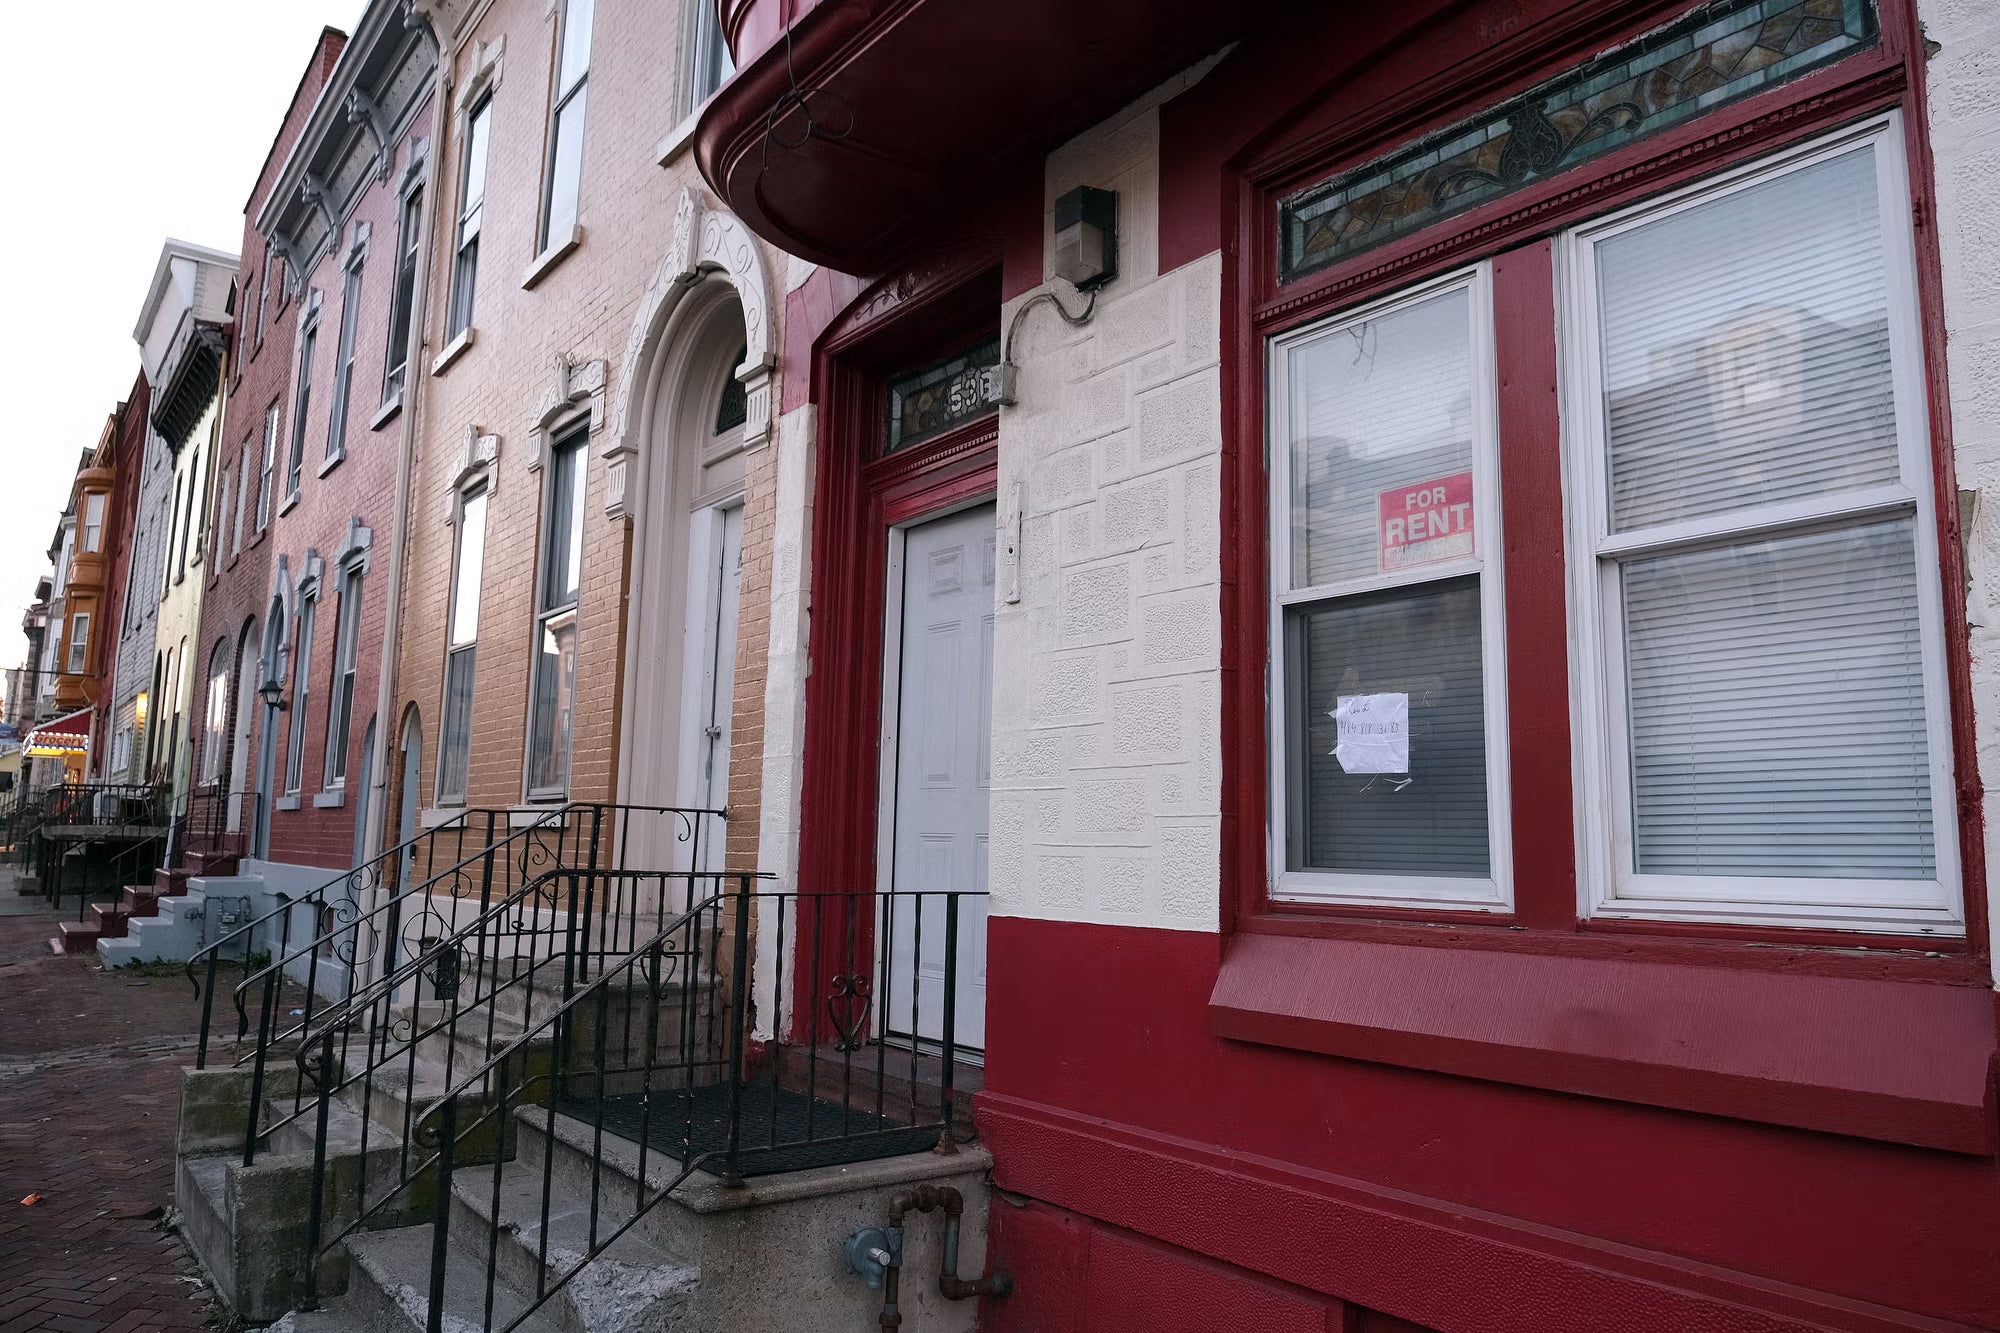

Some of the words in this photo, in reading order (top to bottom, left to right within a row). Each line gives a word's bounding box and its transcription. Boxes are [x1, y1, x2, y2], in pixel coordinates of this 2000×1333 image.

[1405, 486, 1446, 511] FOR
[1385, 502, 1470, 546] RENT
[35, 735, 84, 746] Grocery
